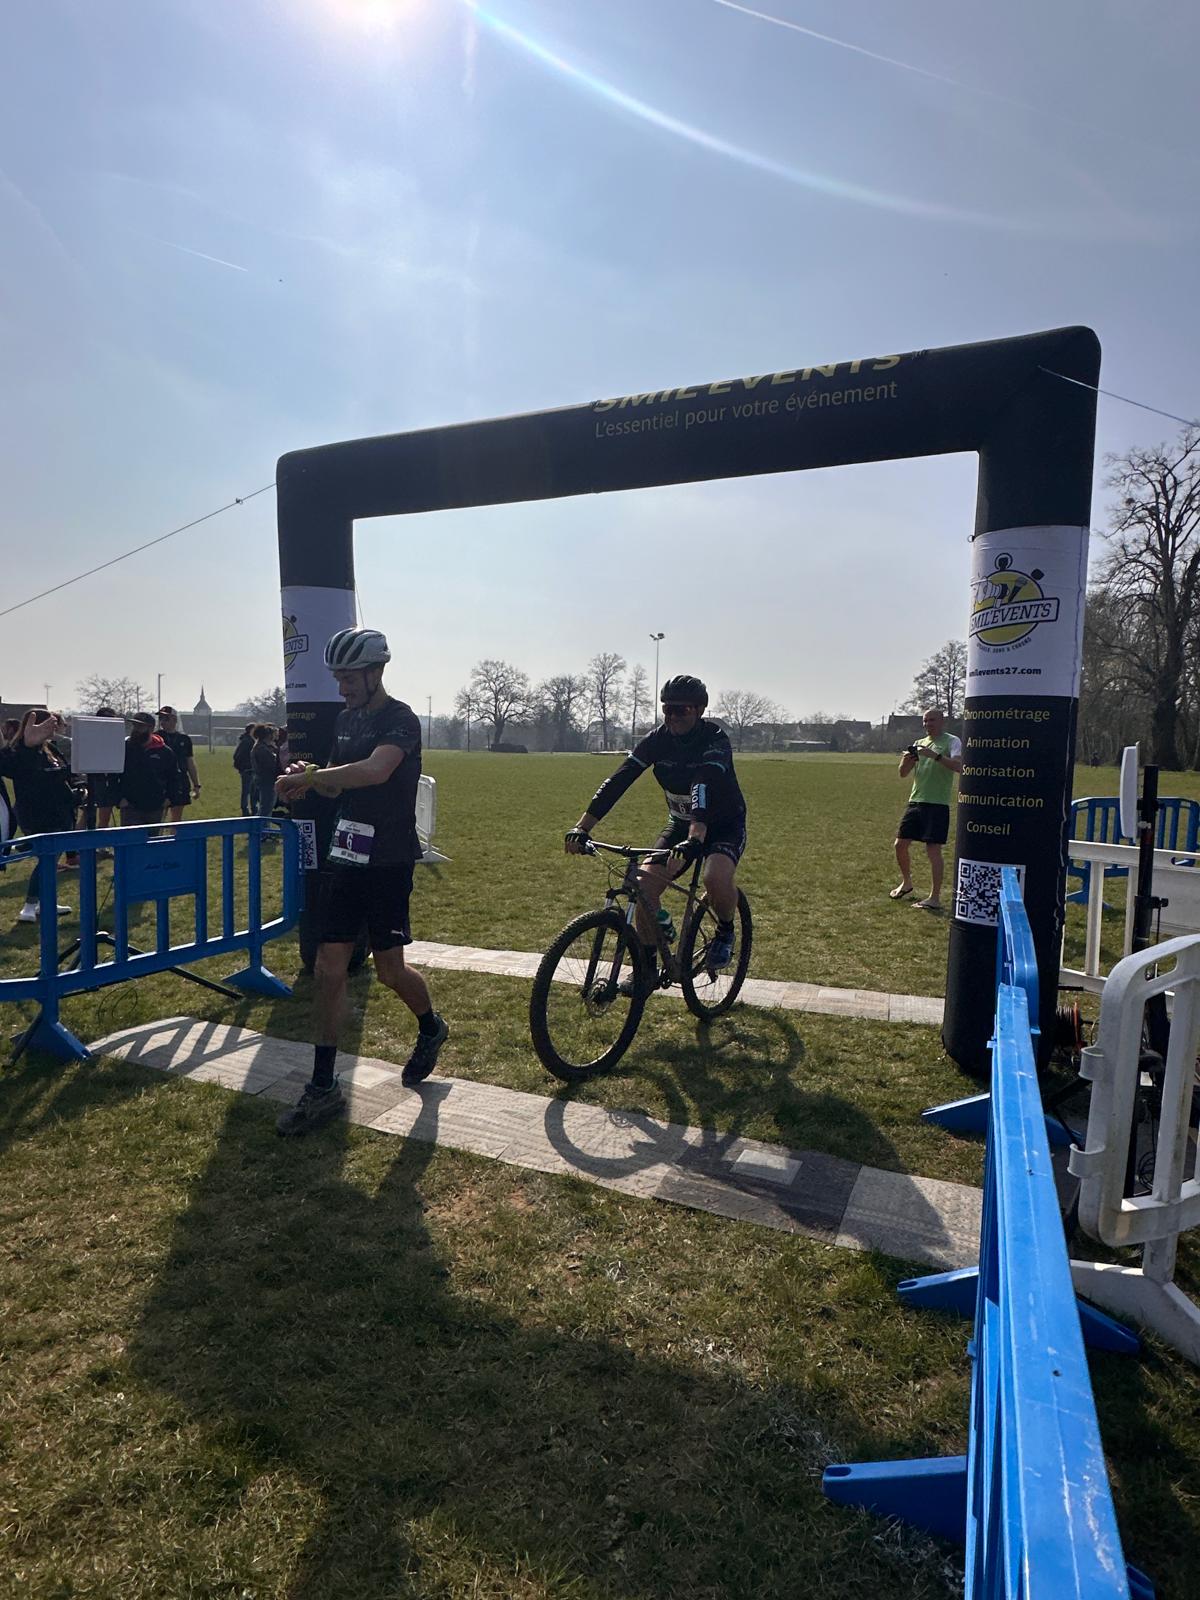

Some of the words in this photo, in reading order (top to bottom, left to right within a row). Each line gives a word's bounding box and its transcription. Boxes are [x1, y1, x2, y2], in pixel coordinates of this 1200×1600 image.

[595, 410, 679, 439] L'essentiel
[685, 405, 726, 430] pour
[733, 397, 779, 418] votre
[786, 380, 898, 421] événement
[963, 707, 1051, 723] Chronométrage
[966, 736, 1030, 749] Animation
[962, 763, 1035, 778] Sonorisation
[958, 791, 1044, 808] Communication
[966, 820, 1011, 836] Conseil
[346, 833, 354, 850] 6
